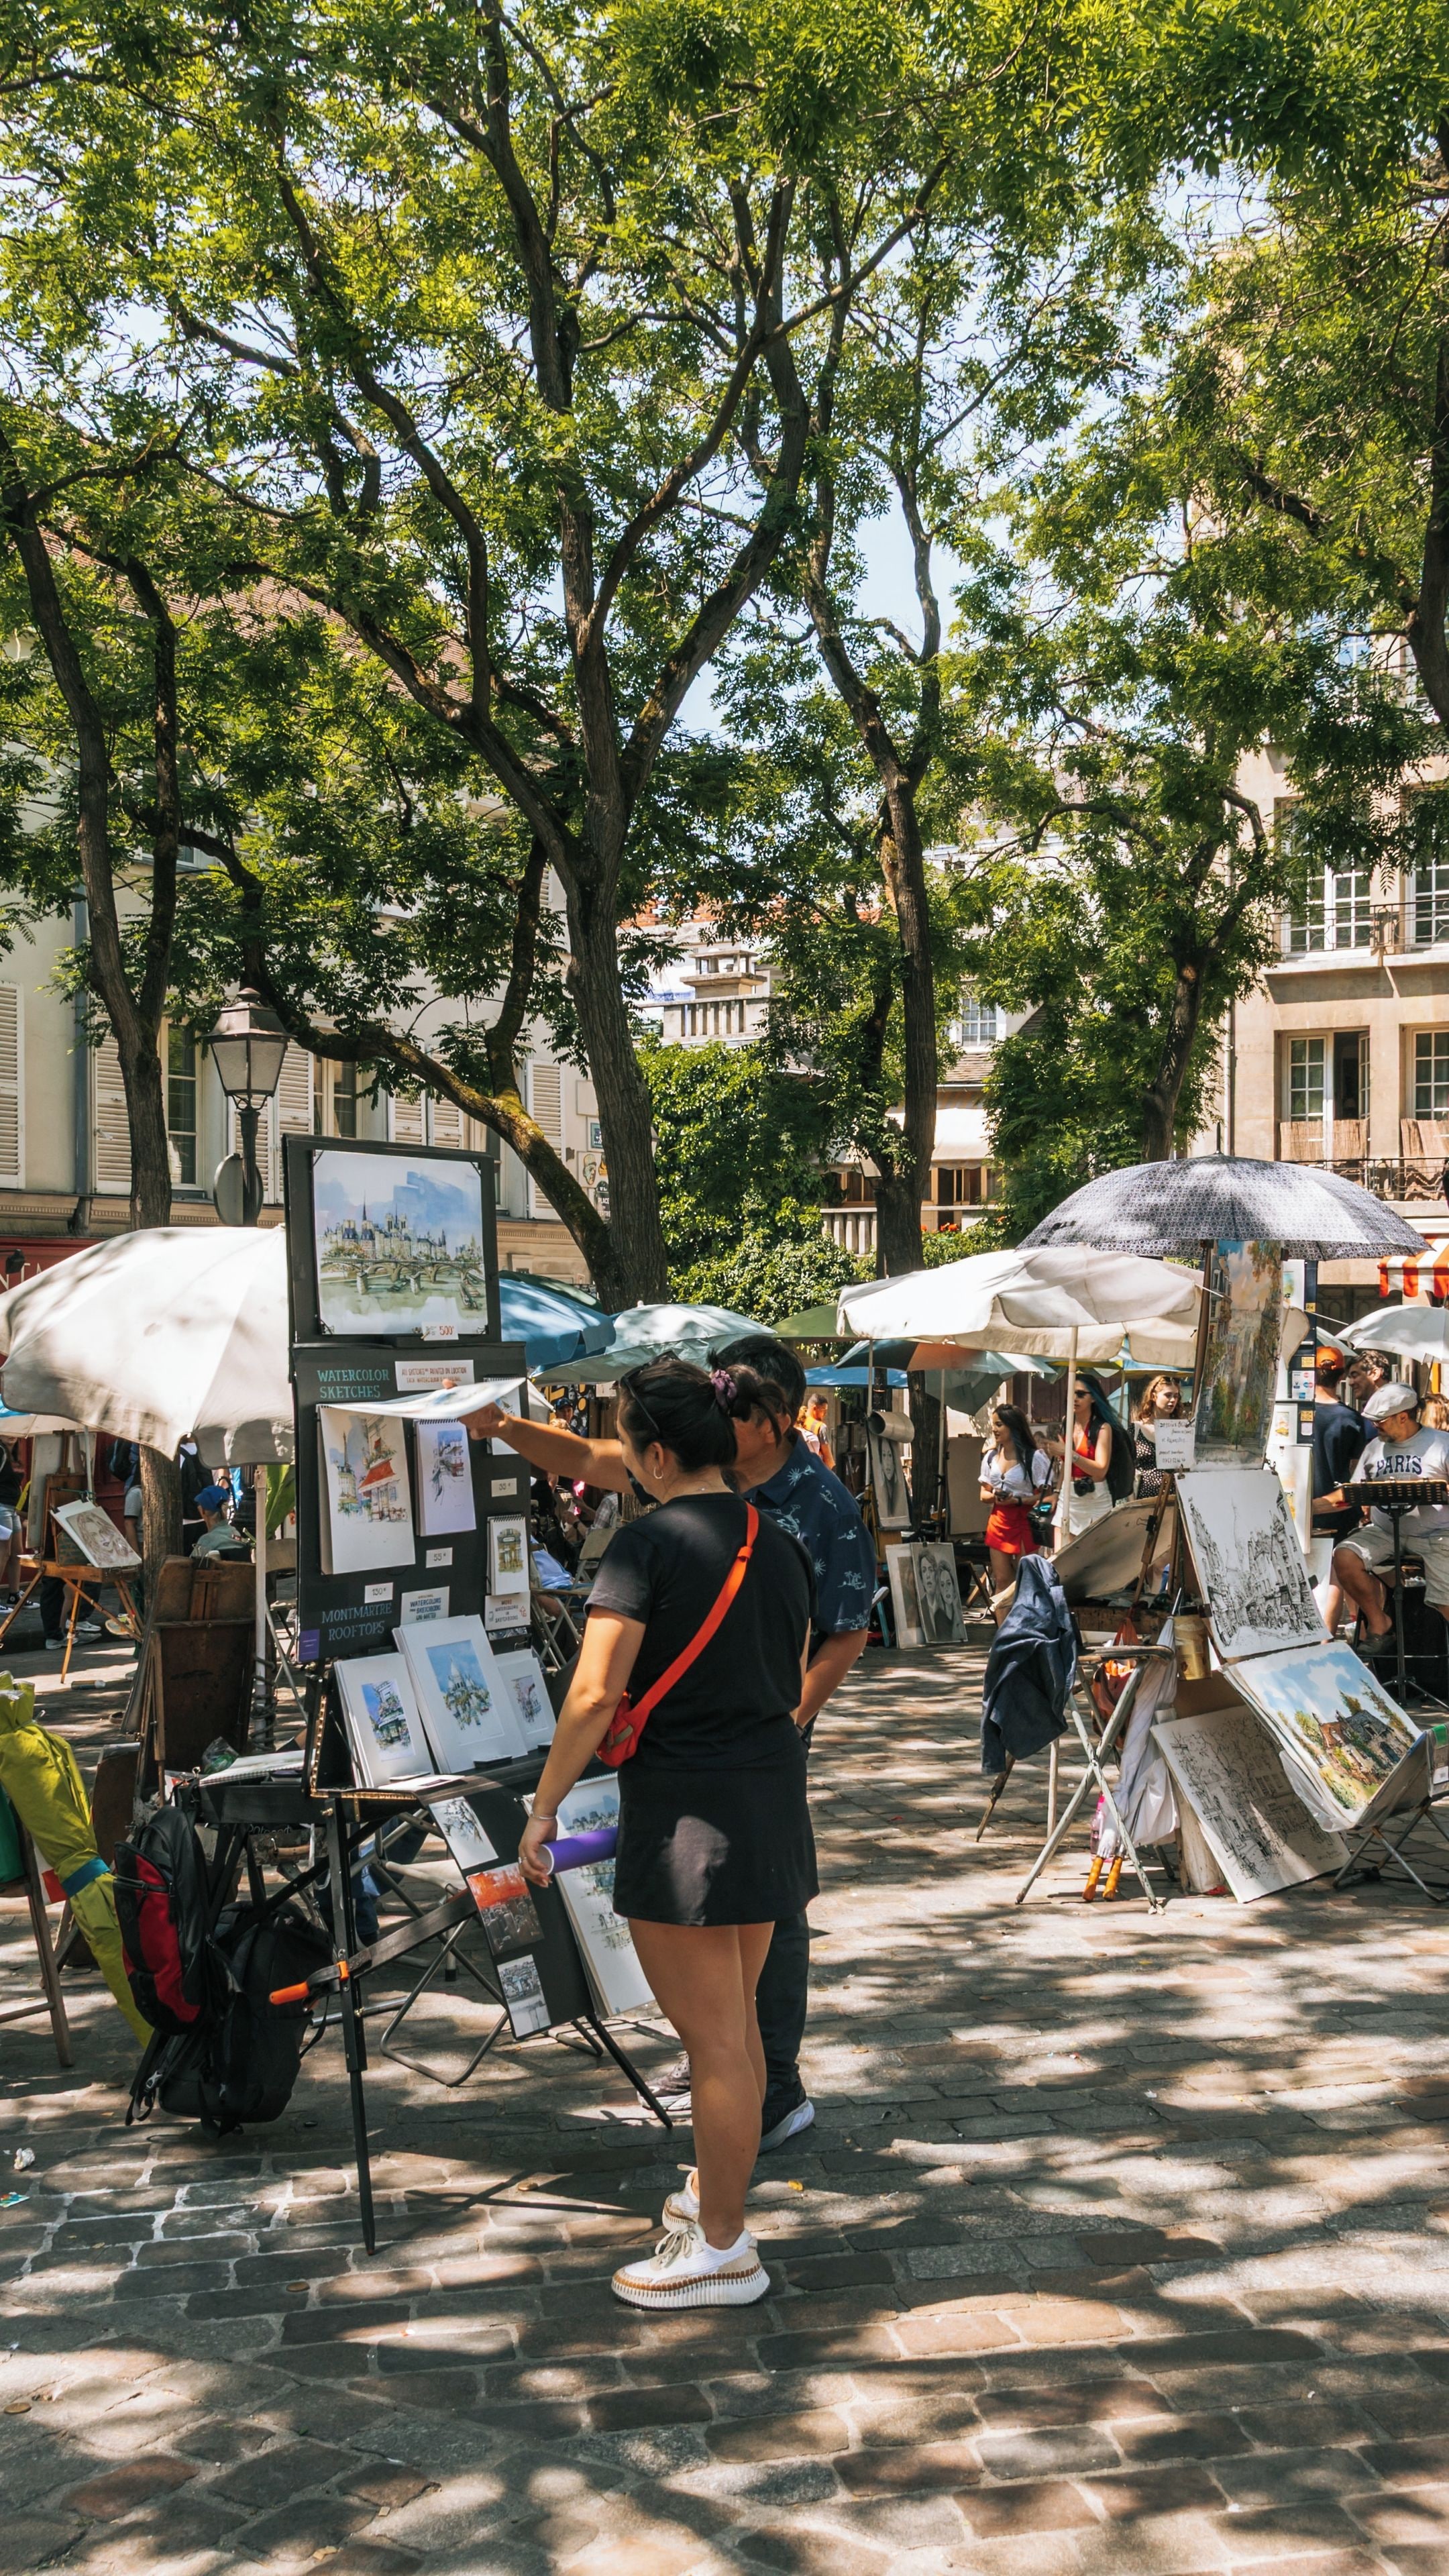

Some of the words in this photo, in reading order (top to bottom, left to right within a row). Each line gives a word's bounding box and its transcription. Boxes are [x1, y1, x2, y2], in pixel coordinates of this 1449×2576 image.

[317, 1369, 390, 1382] WATERCOLOR
[319, 1385, 381, 1399] SKETCHES
[1376, 1455, 1422, 1477] PARIS
[322, 1603, 392, 1623] MONTMARTRE
[329, 1621, 385, 1641] ROOFTOPS
